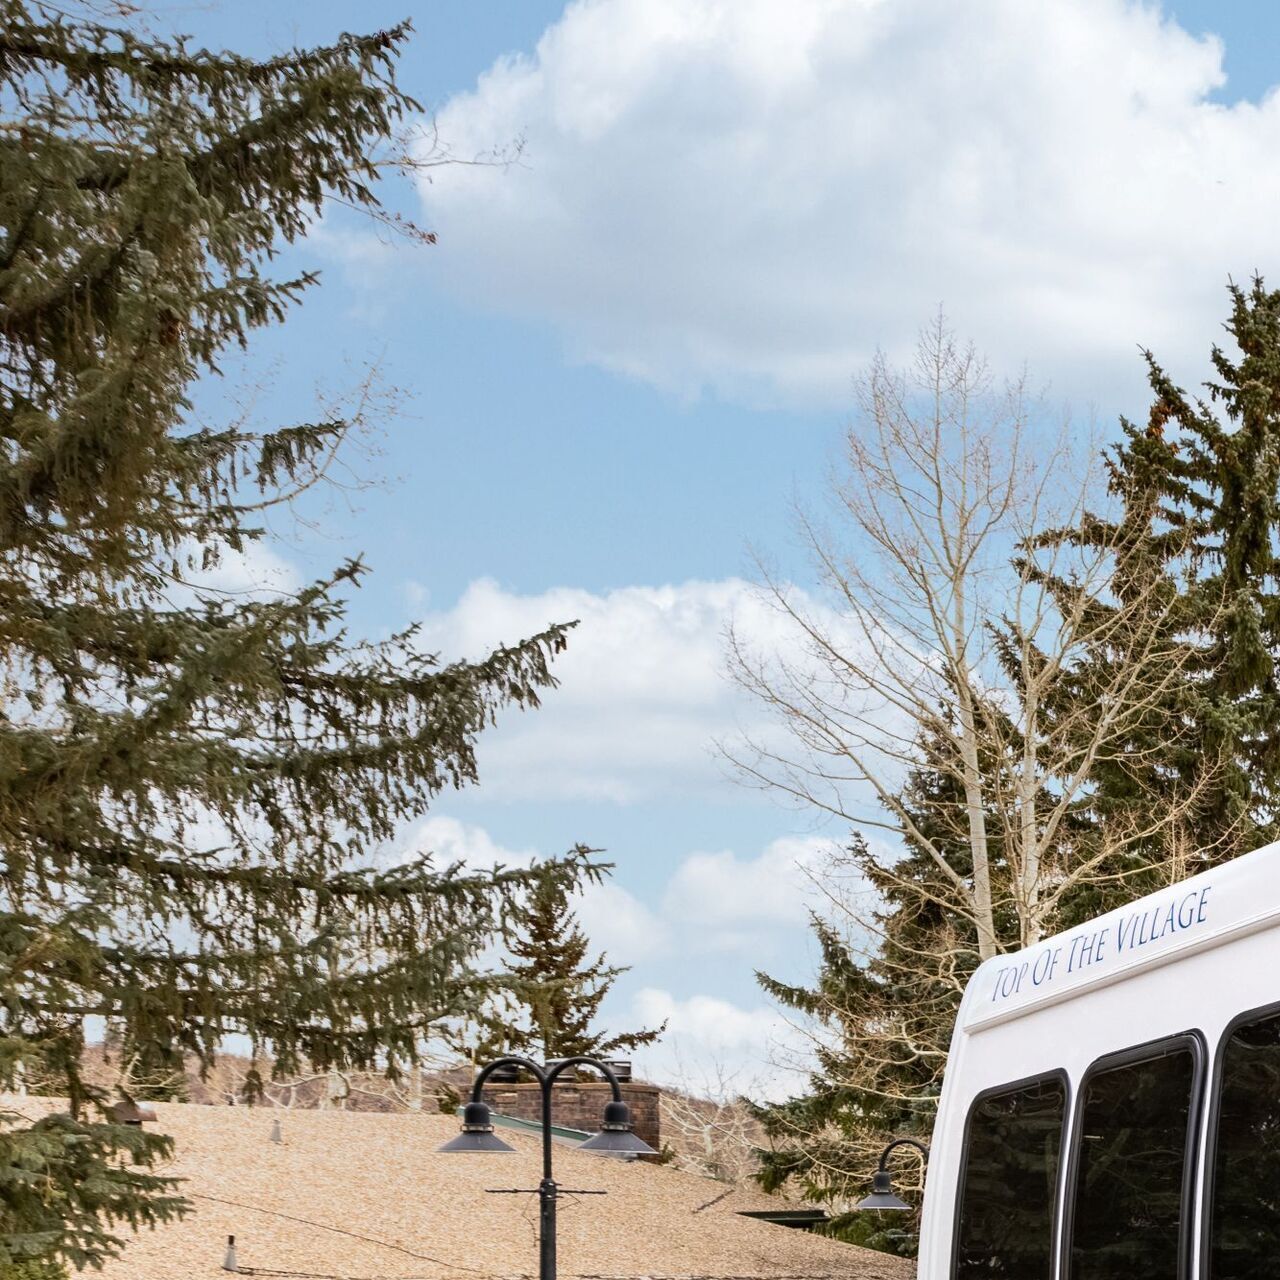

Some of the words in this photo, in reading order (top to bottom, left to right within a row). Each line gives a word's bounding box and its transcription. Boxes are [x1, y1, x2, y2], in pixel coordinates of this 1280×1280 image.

[992, 962, 1029, 1001] TOP
[1032, 947, 1062, 986] OF
[1068, 928, 1110, 973] THE
[1116, 886, 1212, 953] VILLAGE
